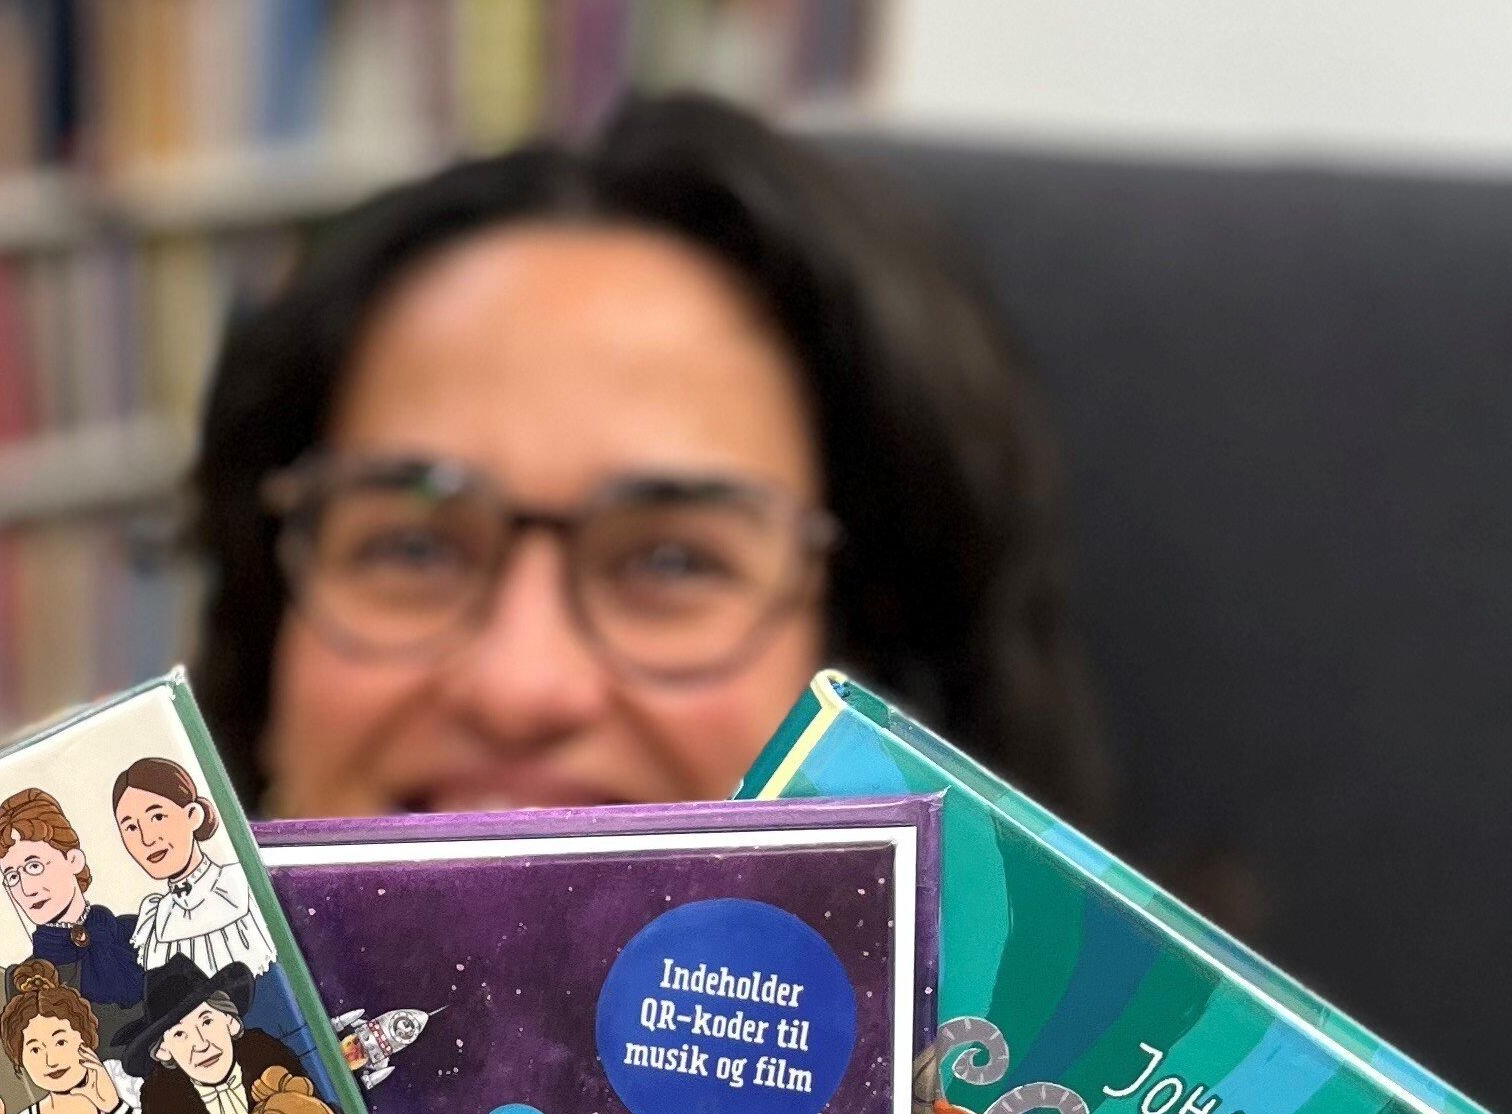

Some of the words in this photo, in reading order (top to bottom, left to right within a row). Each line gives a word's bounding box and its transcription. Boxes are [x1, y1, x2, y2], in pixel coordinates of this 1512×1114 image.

[659, 958, 804, 1008] Indeholder
[640, 997, 770, 1044] QR-koder
[776, 1018, 810, 1052] til
[623, 1042, 709, 1077] musik
[716, 1056, 748, 1088] og
[753, 1055, 813, 1093] film
